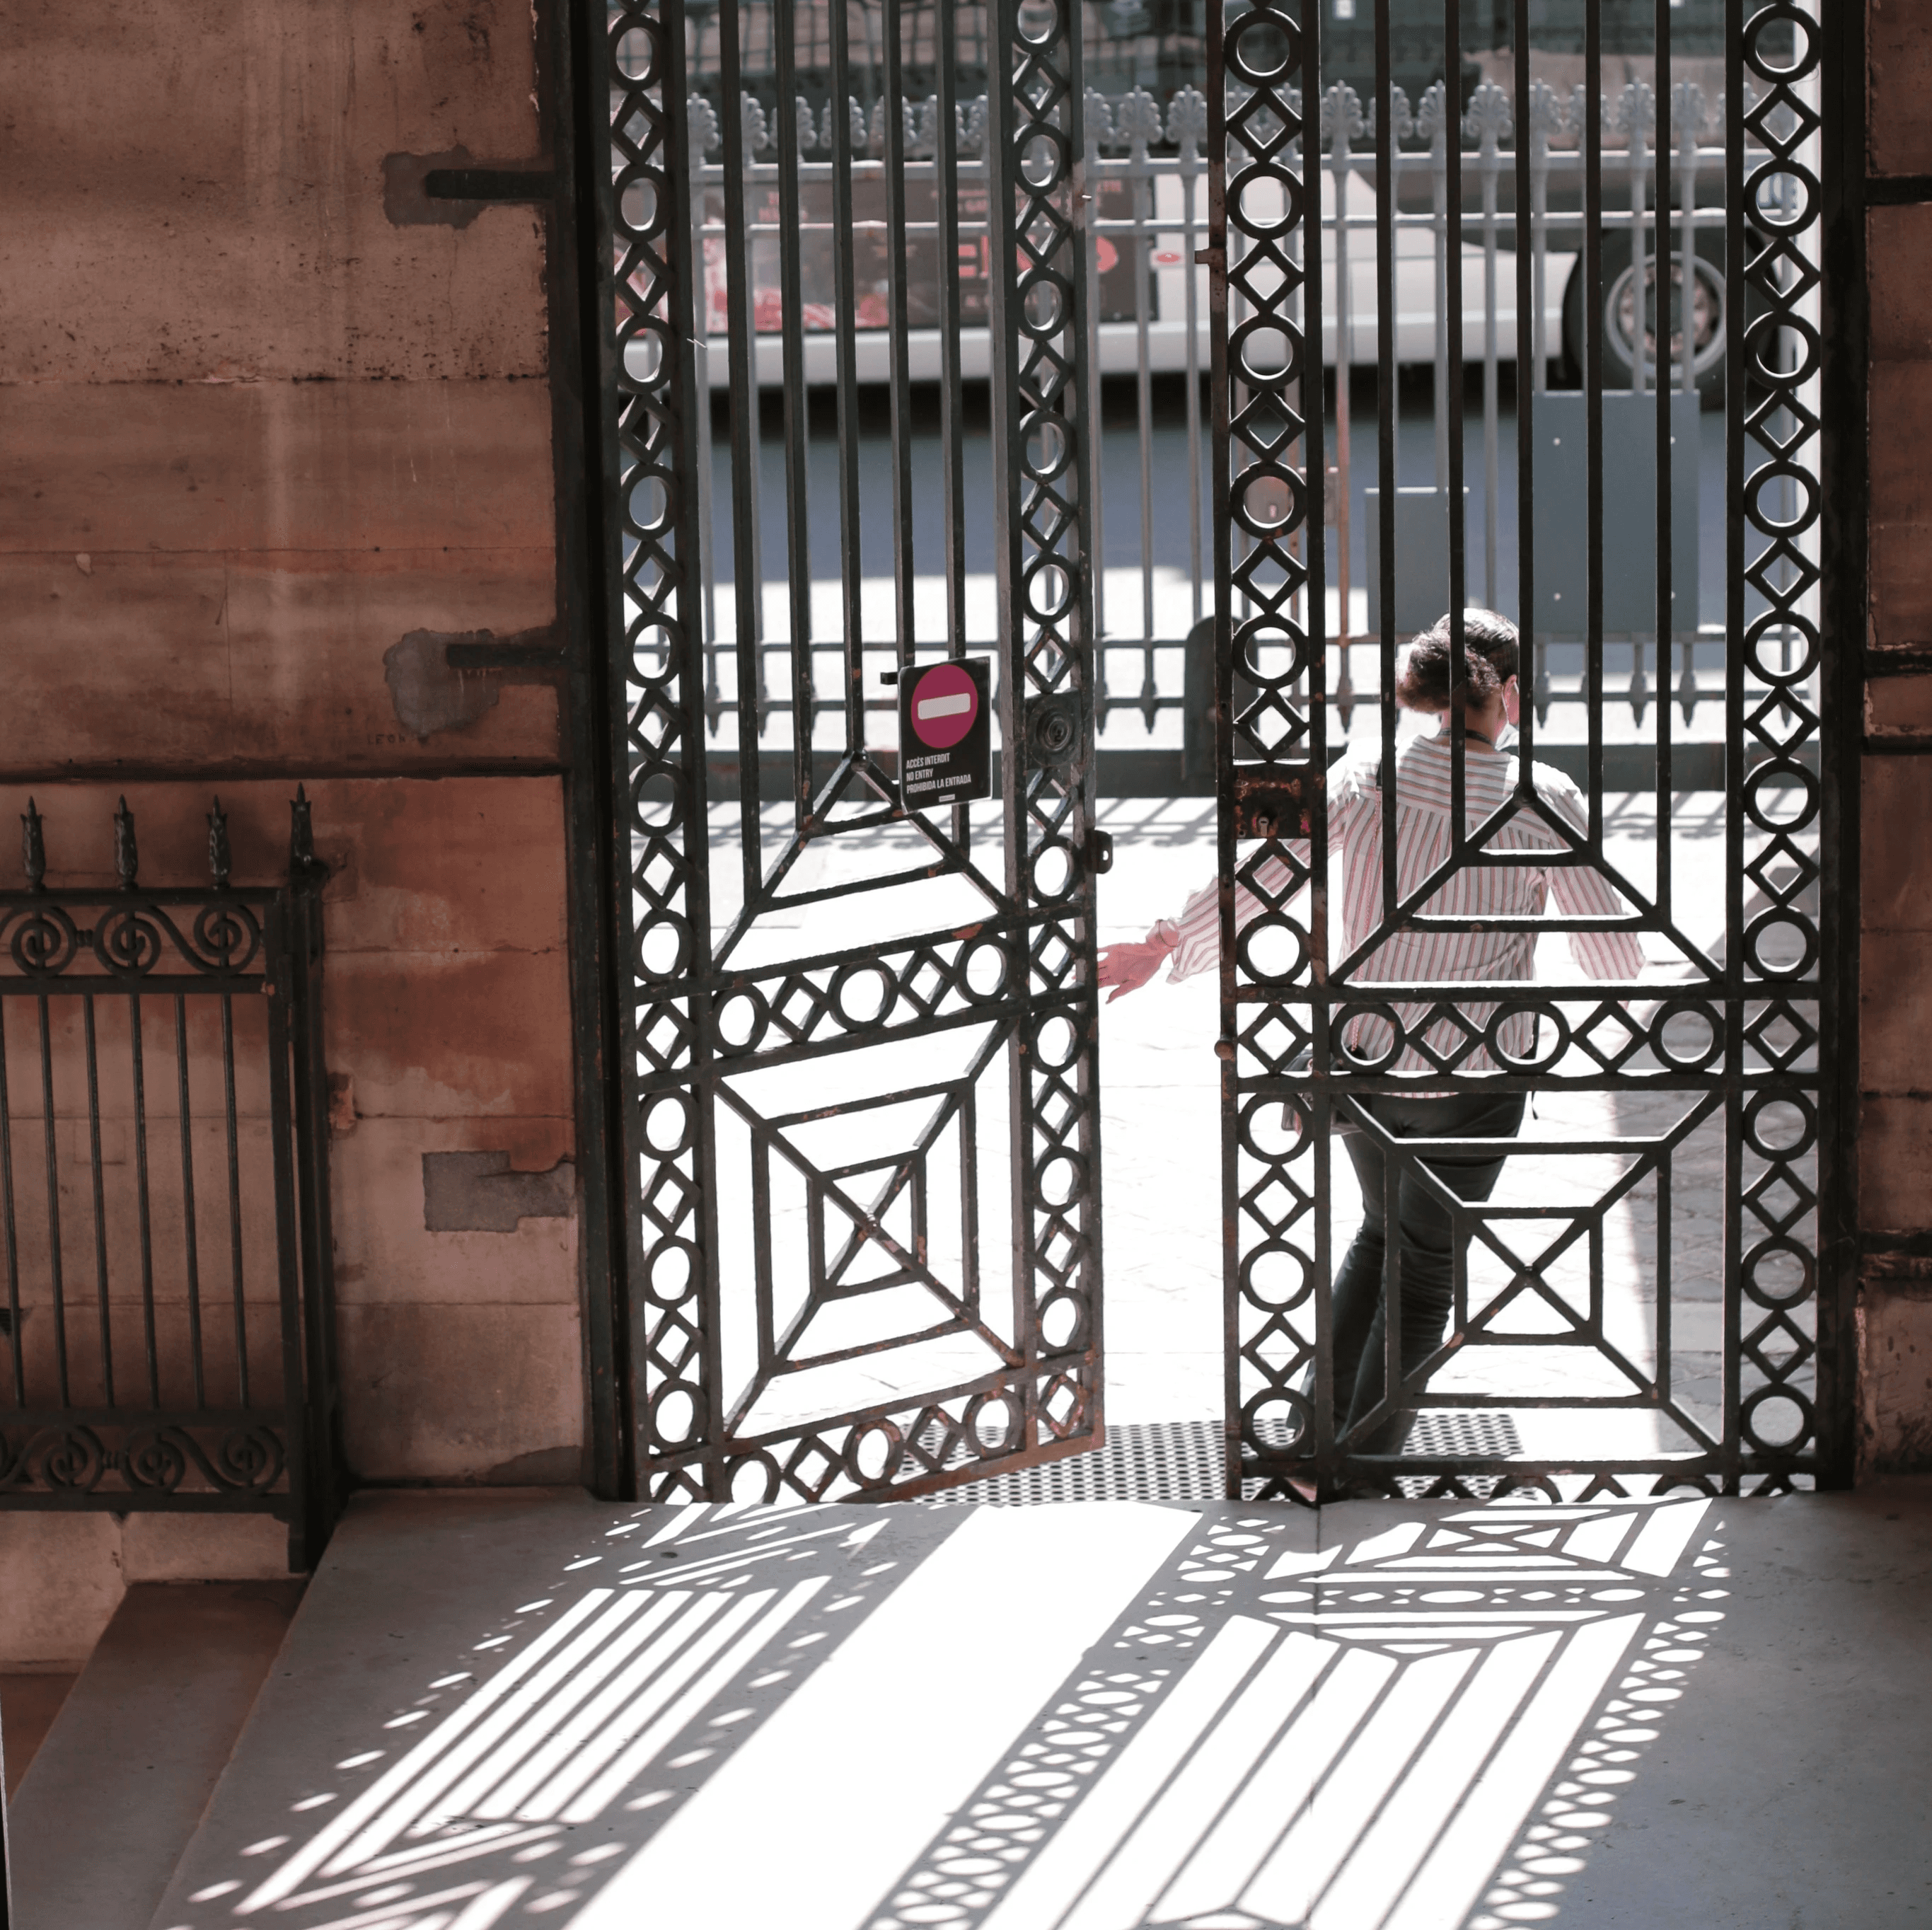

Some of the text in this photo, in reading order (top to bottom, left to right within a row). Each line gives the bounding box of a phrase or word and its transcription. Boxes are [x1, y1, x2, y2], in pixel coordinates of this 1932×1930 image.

[906, 753, 950, 769] ACCÈS INTERDIT
[906, 768, 934, 782] NO ENTRY
[906, 774, 971, 794] PROHIBIDA LA ENTRADA
